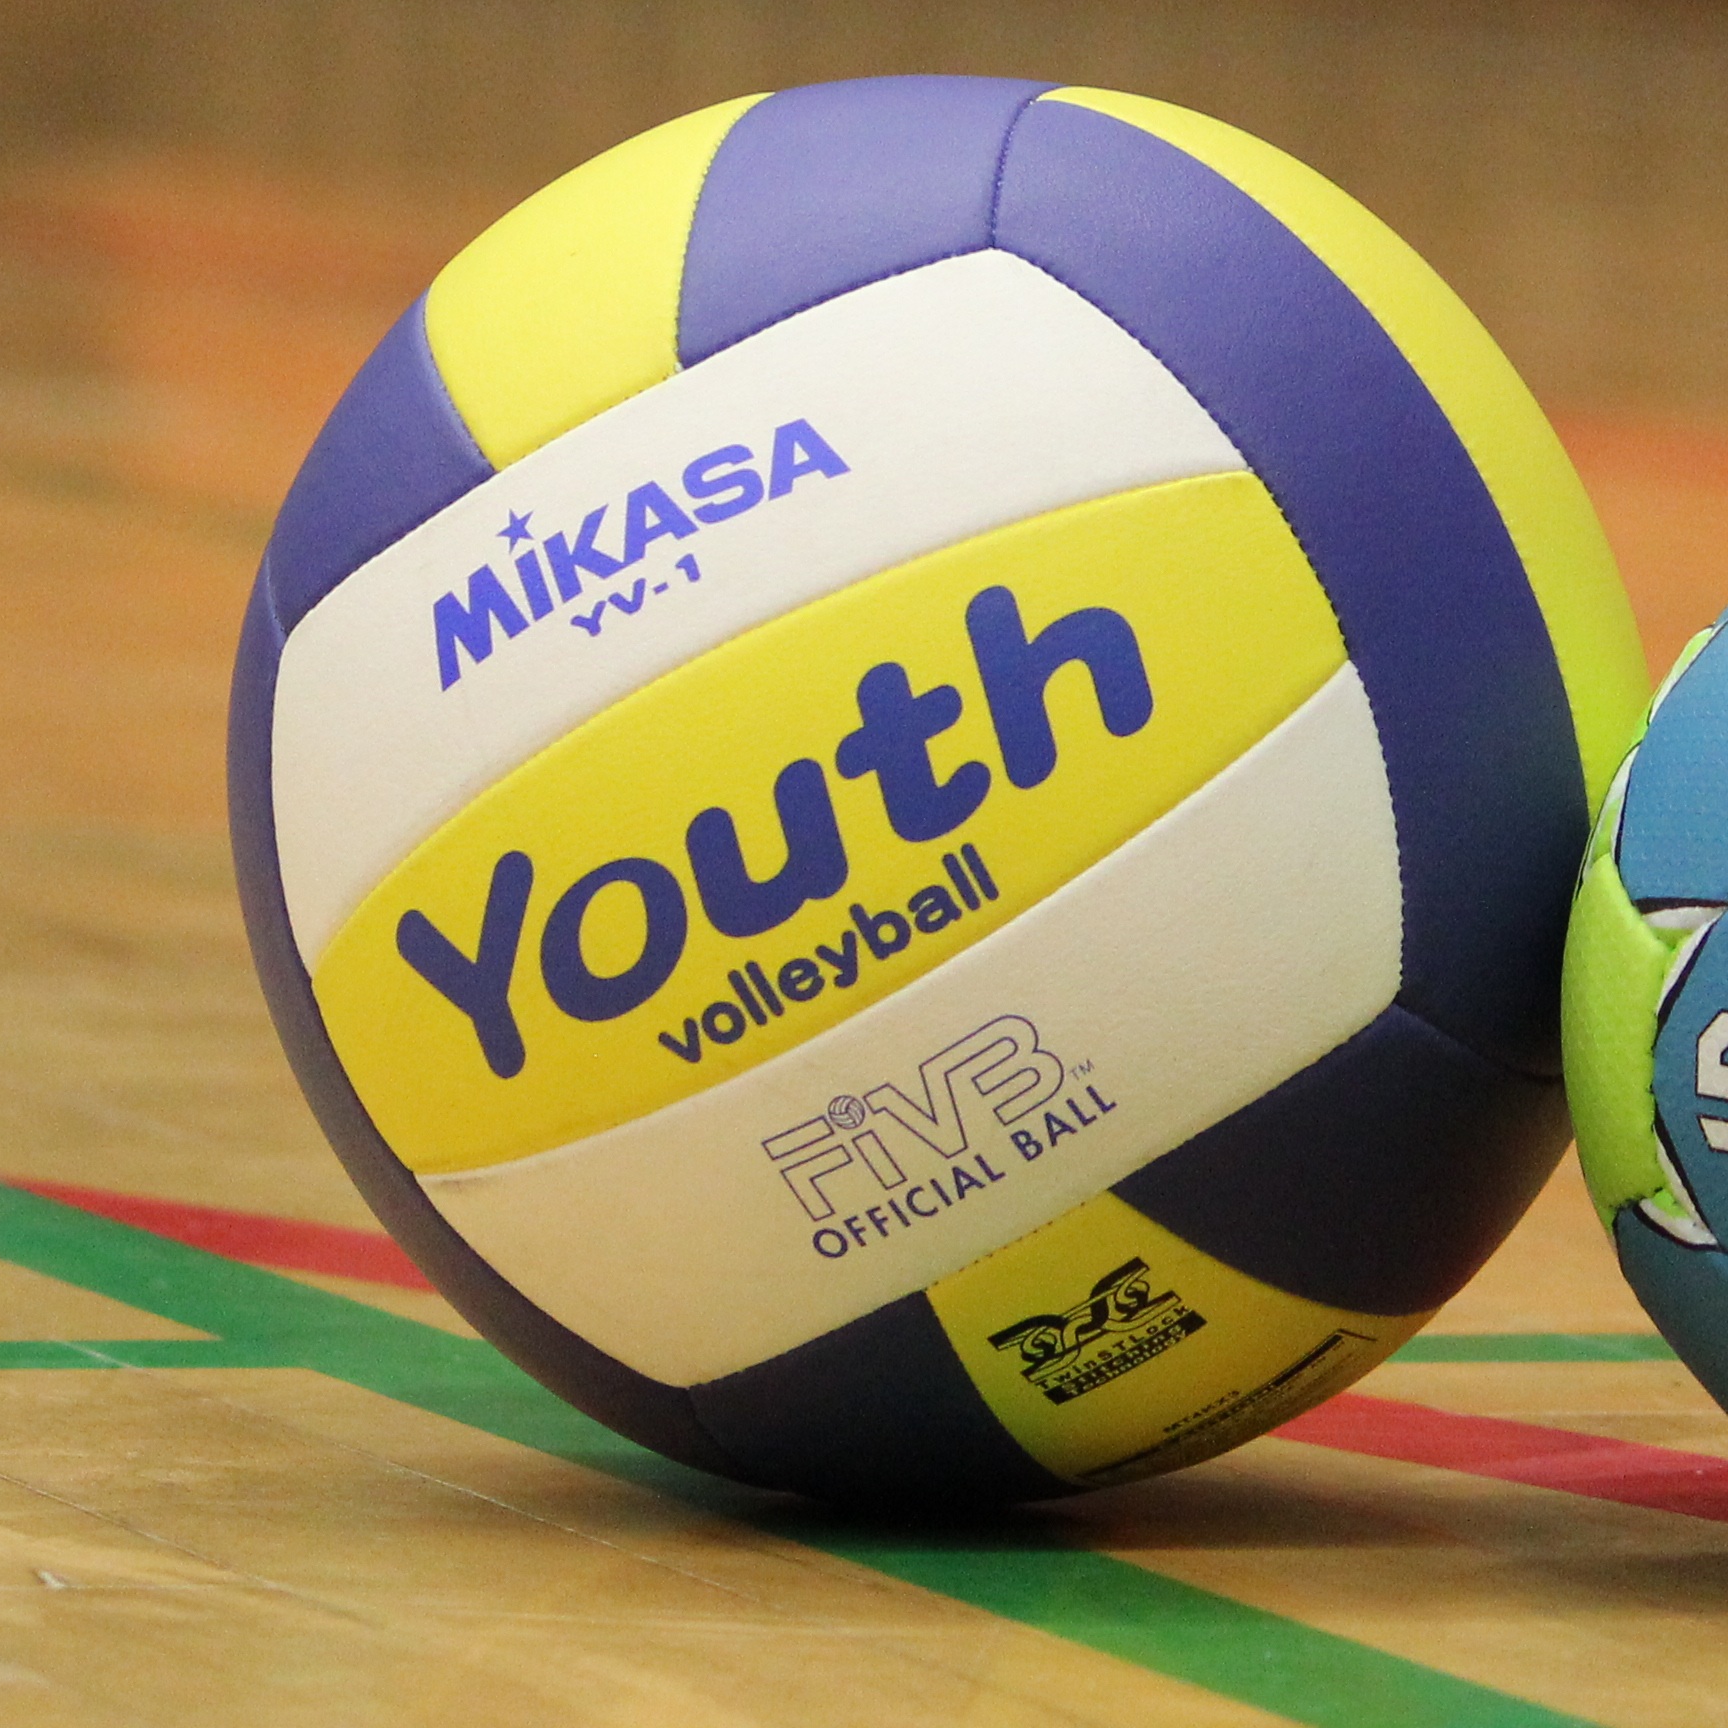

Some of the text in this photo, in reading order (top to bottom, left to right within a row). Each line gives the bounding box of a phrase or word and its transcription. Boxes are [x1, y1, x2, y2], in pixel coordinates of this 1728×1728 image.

[570, 553, 701, 637] YV-1
[395, 585, 1154, 1079] Youth
[658, 842, 1000, 1064] volleyball
[812, 1085, 1117, 1259] OFFICIAL BALL
